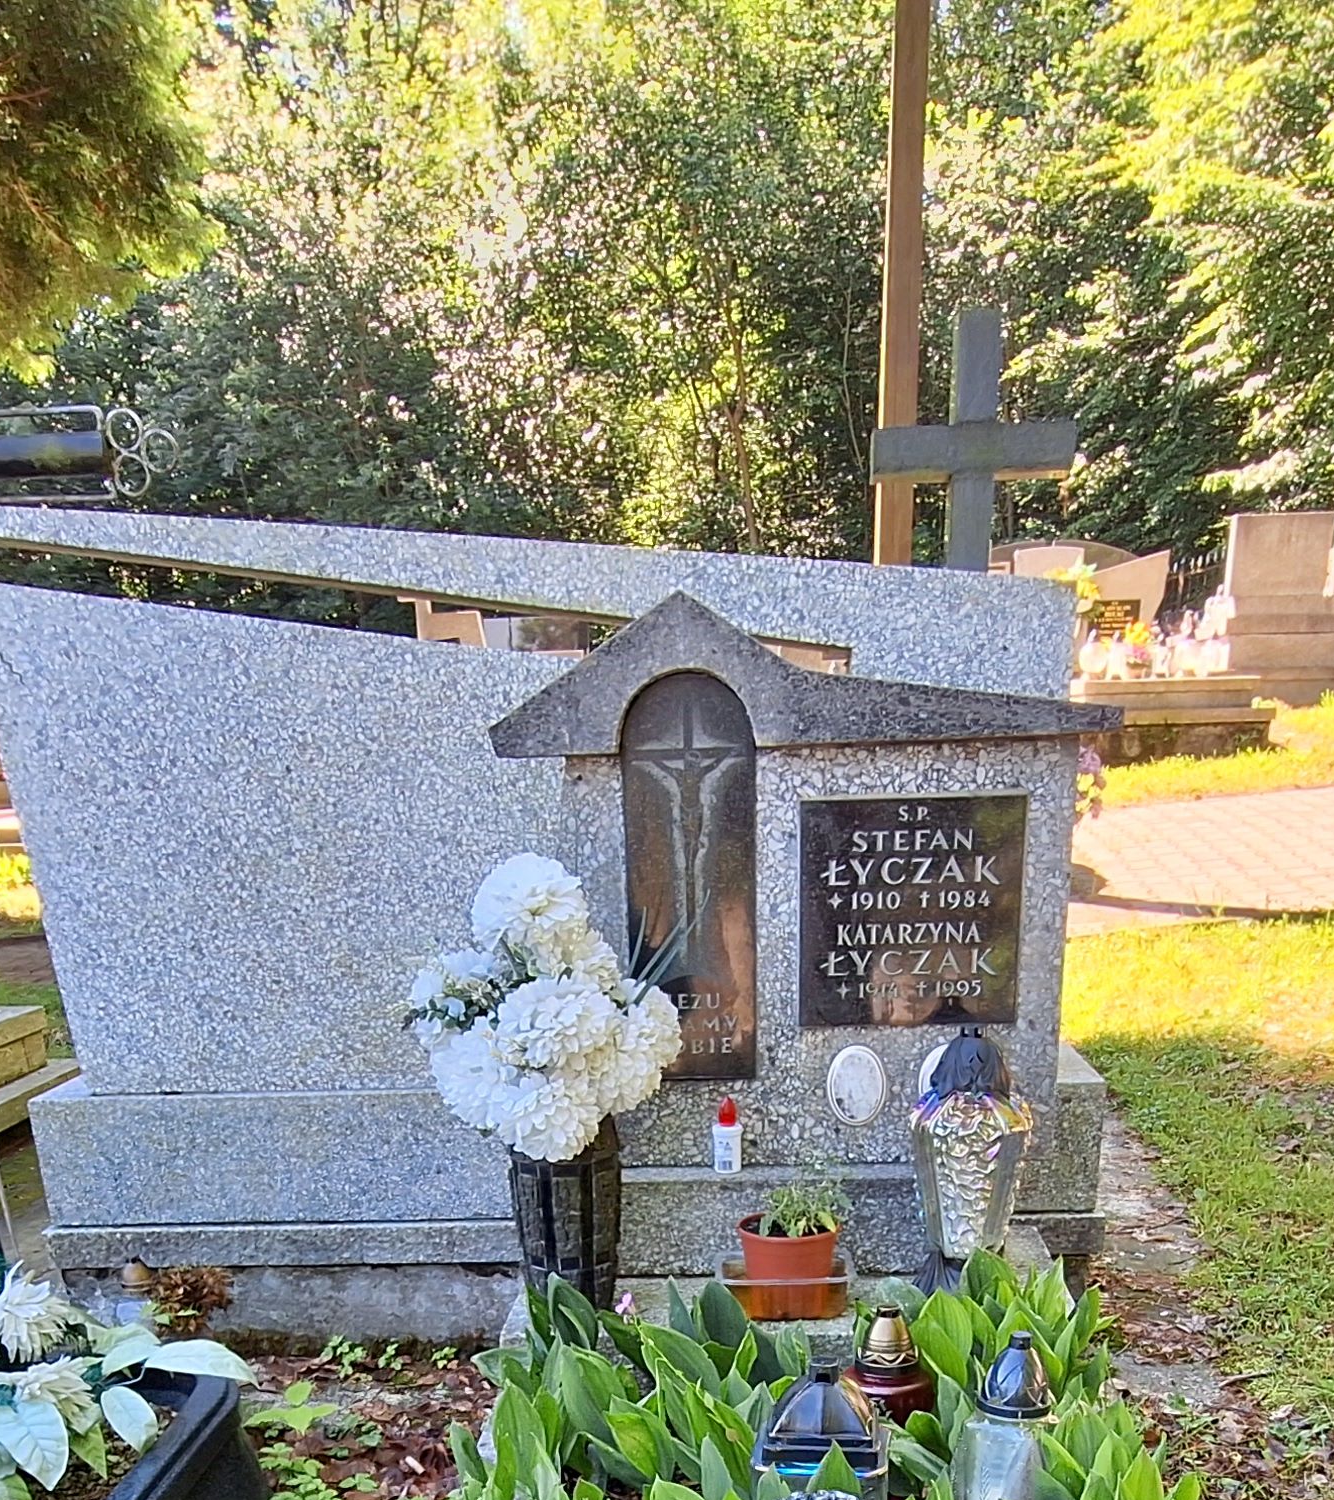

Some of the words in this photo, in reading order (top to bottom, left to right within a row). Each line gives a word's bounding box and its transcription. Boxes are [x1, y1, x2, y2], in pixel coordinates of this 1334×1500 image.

[851, 828, 973, 852] STEFAN
[820, 855, 1000, 885] ŁYCZAK
[851, 891, 901, 910] 1910
[938, 890, 991, 910] 1984
[836, 921, 981, 946] KATARZYNA
[819, 948, 997, 976] ŁYCZAK
[858, 981, 899, 998] 1914
[935, 979, 983, 997] 1995
